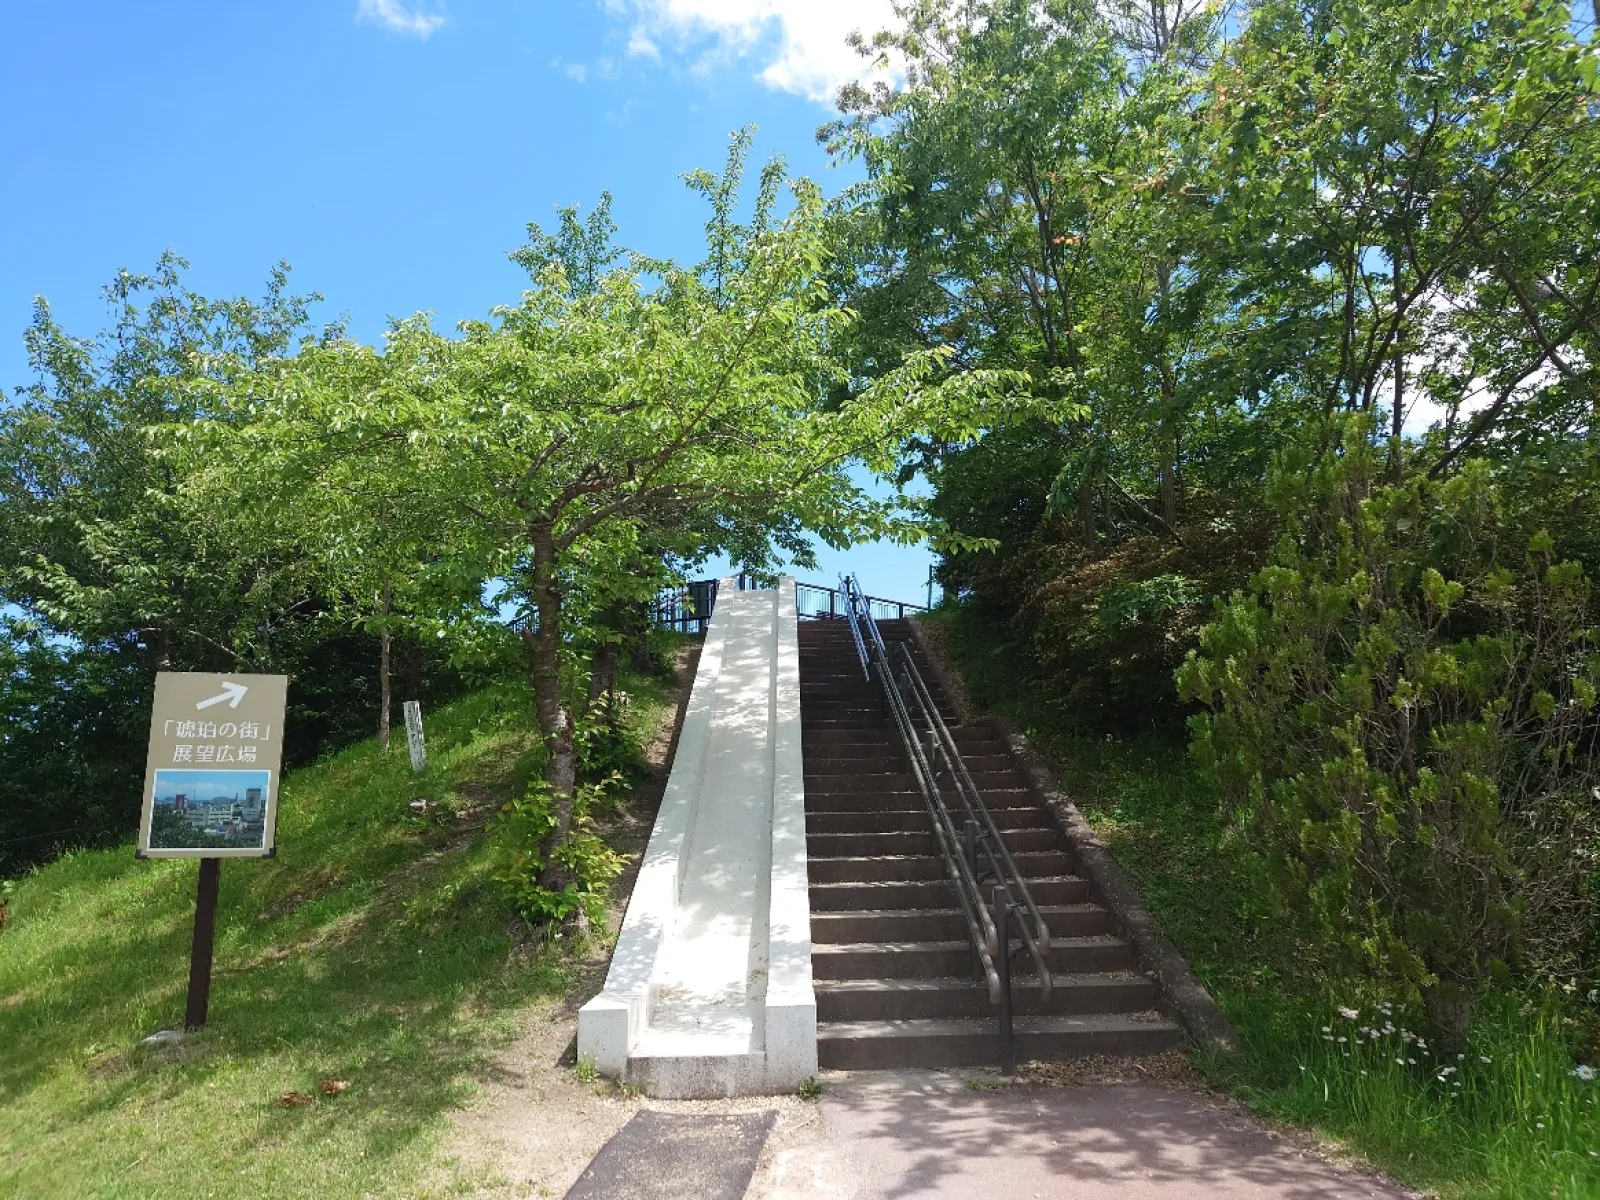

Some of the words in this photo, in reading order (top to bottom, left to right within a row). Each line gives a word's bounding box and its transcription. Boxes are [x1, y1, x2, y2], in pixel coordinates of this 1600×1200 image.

[164, 719, 270, 740] 「琥珀の街」
[172, 744, 257, 763] 展望広場
